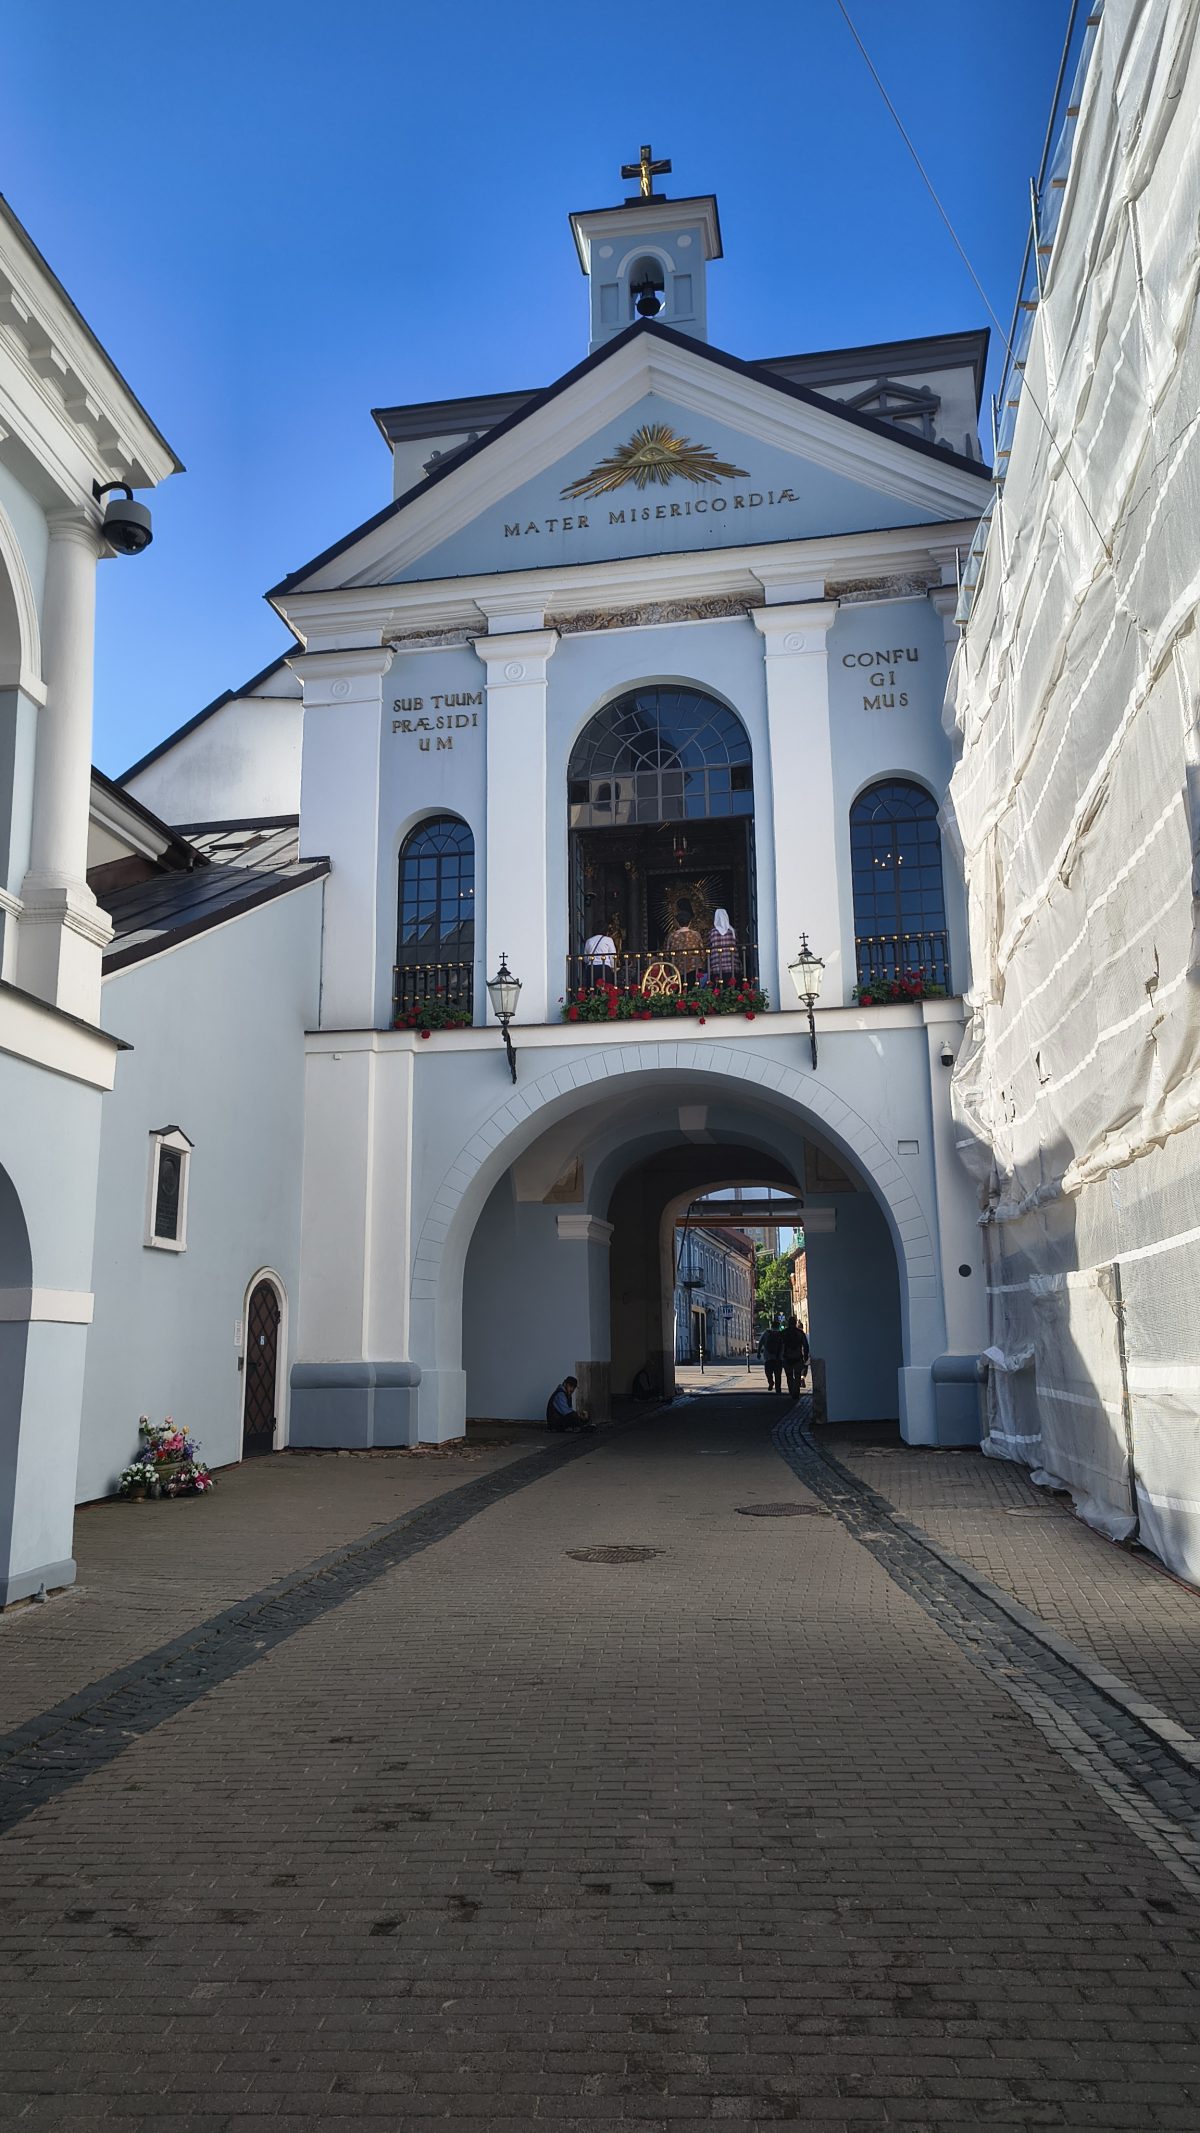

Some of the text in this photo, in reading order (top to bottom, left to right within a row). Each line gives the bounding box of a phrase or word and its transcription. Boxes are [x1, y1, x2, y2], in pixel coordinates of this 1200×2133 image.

[504, 488, 801, 538] MATER MISERICORDIÆ
[842, 647, 919, 668] CONFU
[869, 670, 896, 687] GI
[393, 691, 483, 712] SUB TUUM
[863, 692, 908, 711] MUS
[392, 713, 478, 734] PRÆSIDI
[419, 736, 453, 752] UM
